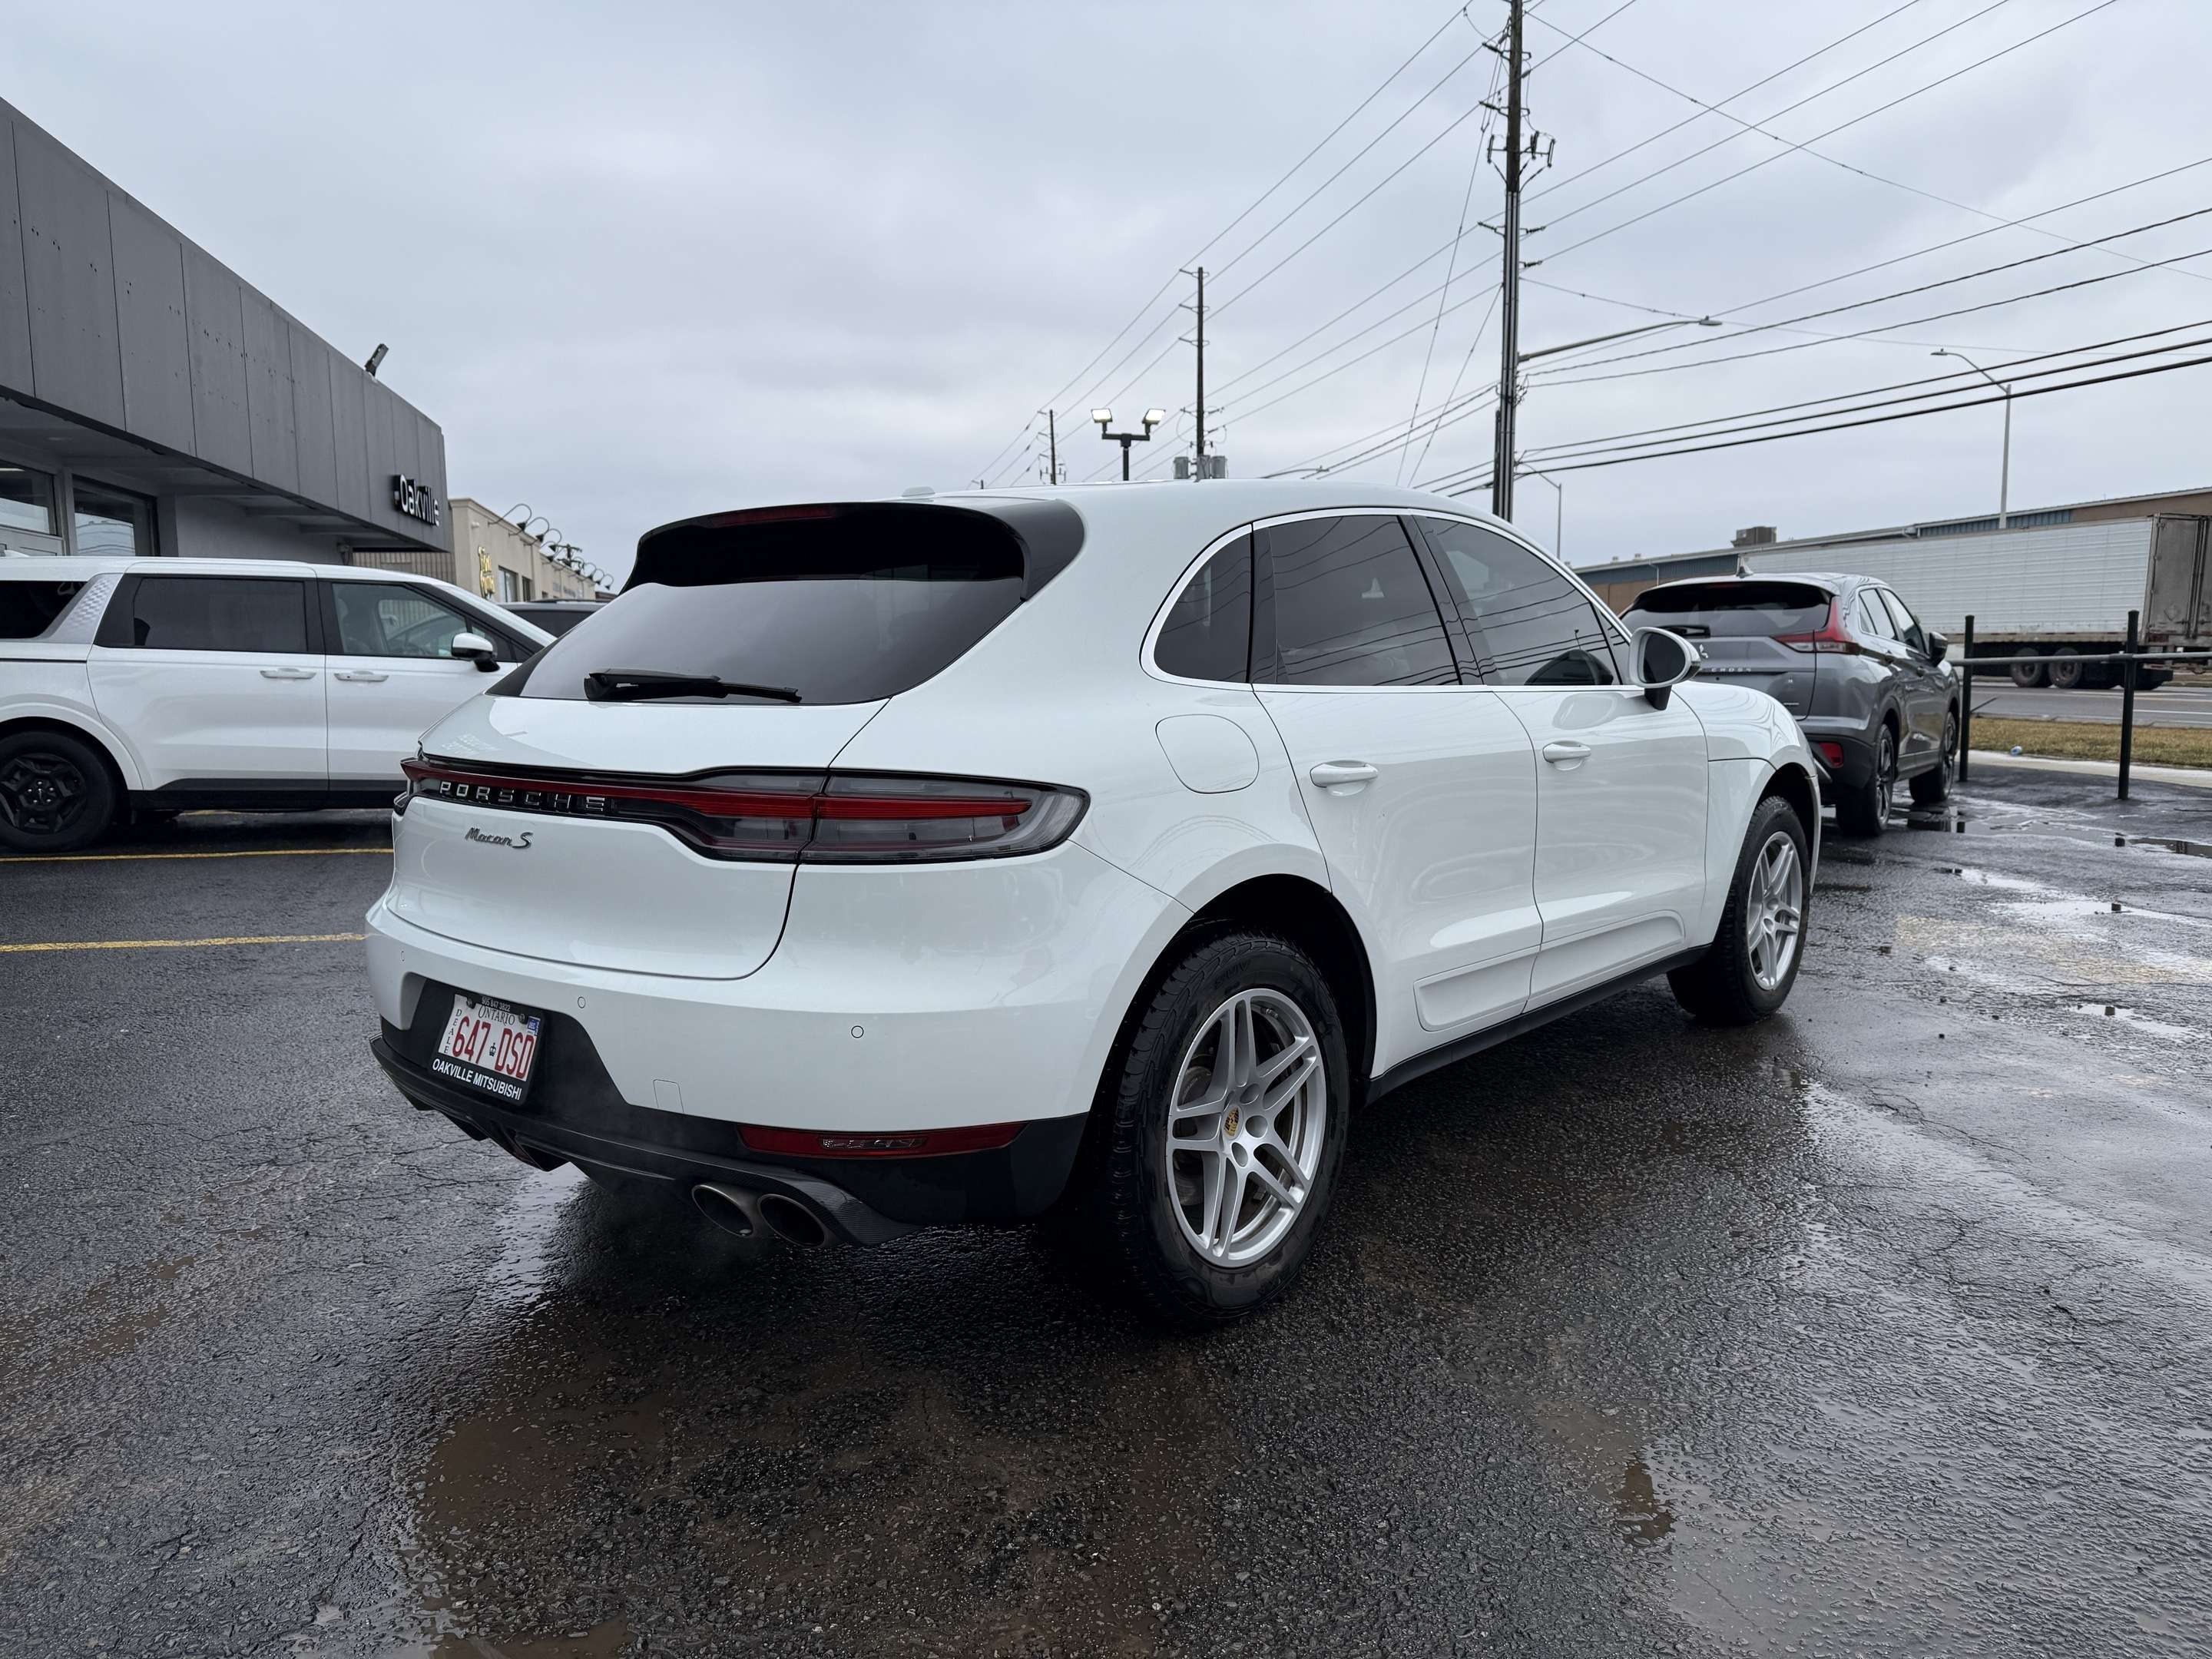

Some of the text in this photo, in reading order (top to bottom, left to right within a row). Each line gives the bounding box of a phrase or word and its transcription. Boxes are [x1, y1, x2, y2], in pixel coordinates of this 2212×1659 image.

[399, 474, 440, 527] Oakville
[440, 780, 605, 812] PORSCHE
[464, 827, 534, 849] Macan S
[444, 1008, 462, 1055] DEALE
[478, 1005, 515, 1026] ONTARIO
[452, 1015, 535, 1079] 647 DSD
[432, 1058, 522, 1100] OAKVILLE MITSUBISHI
